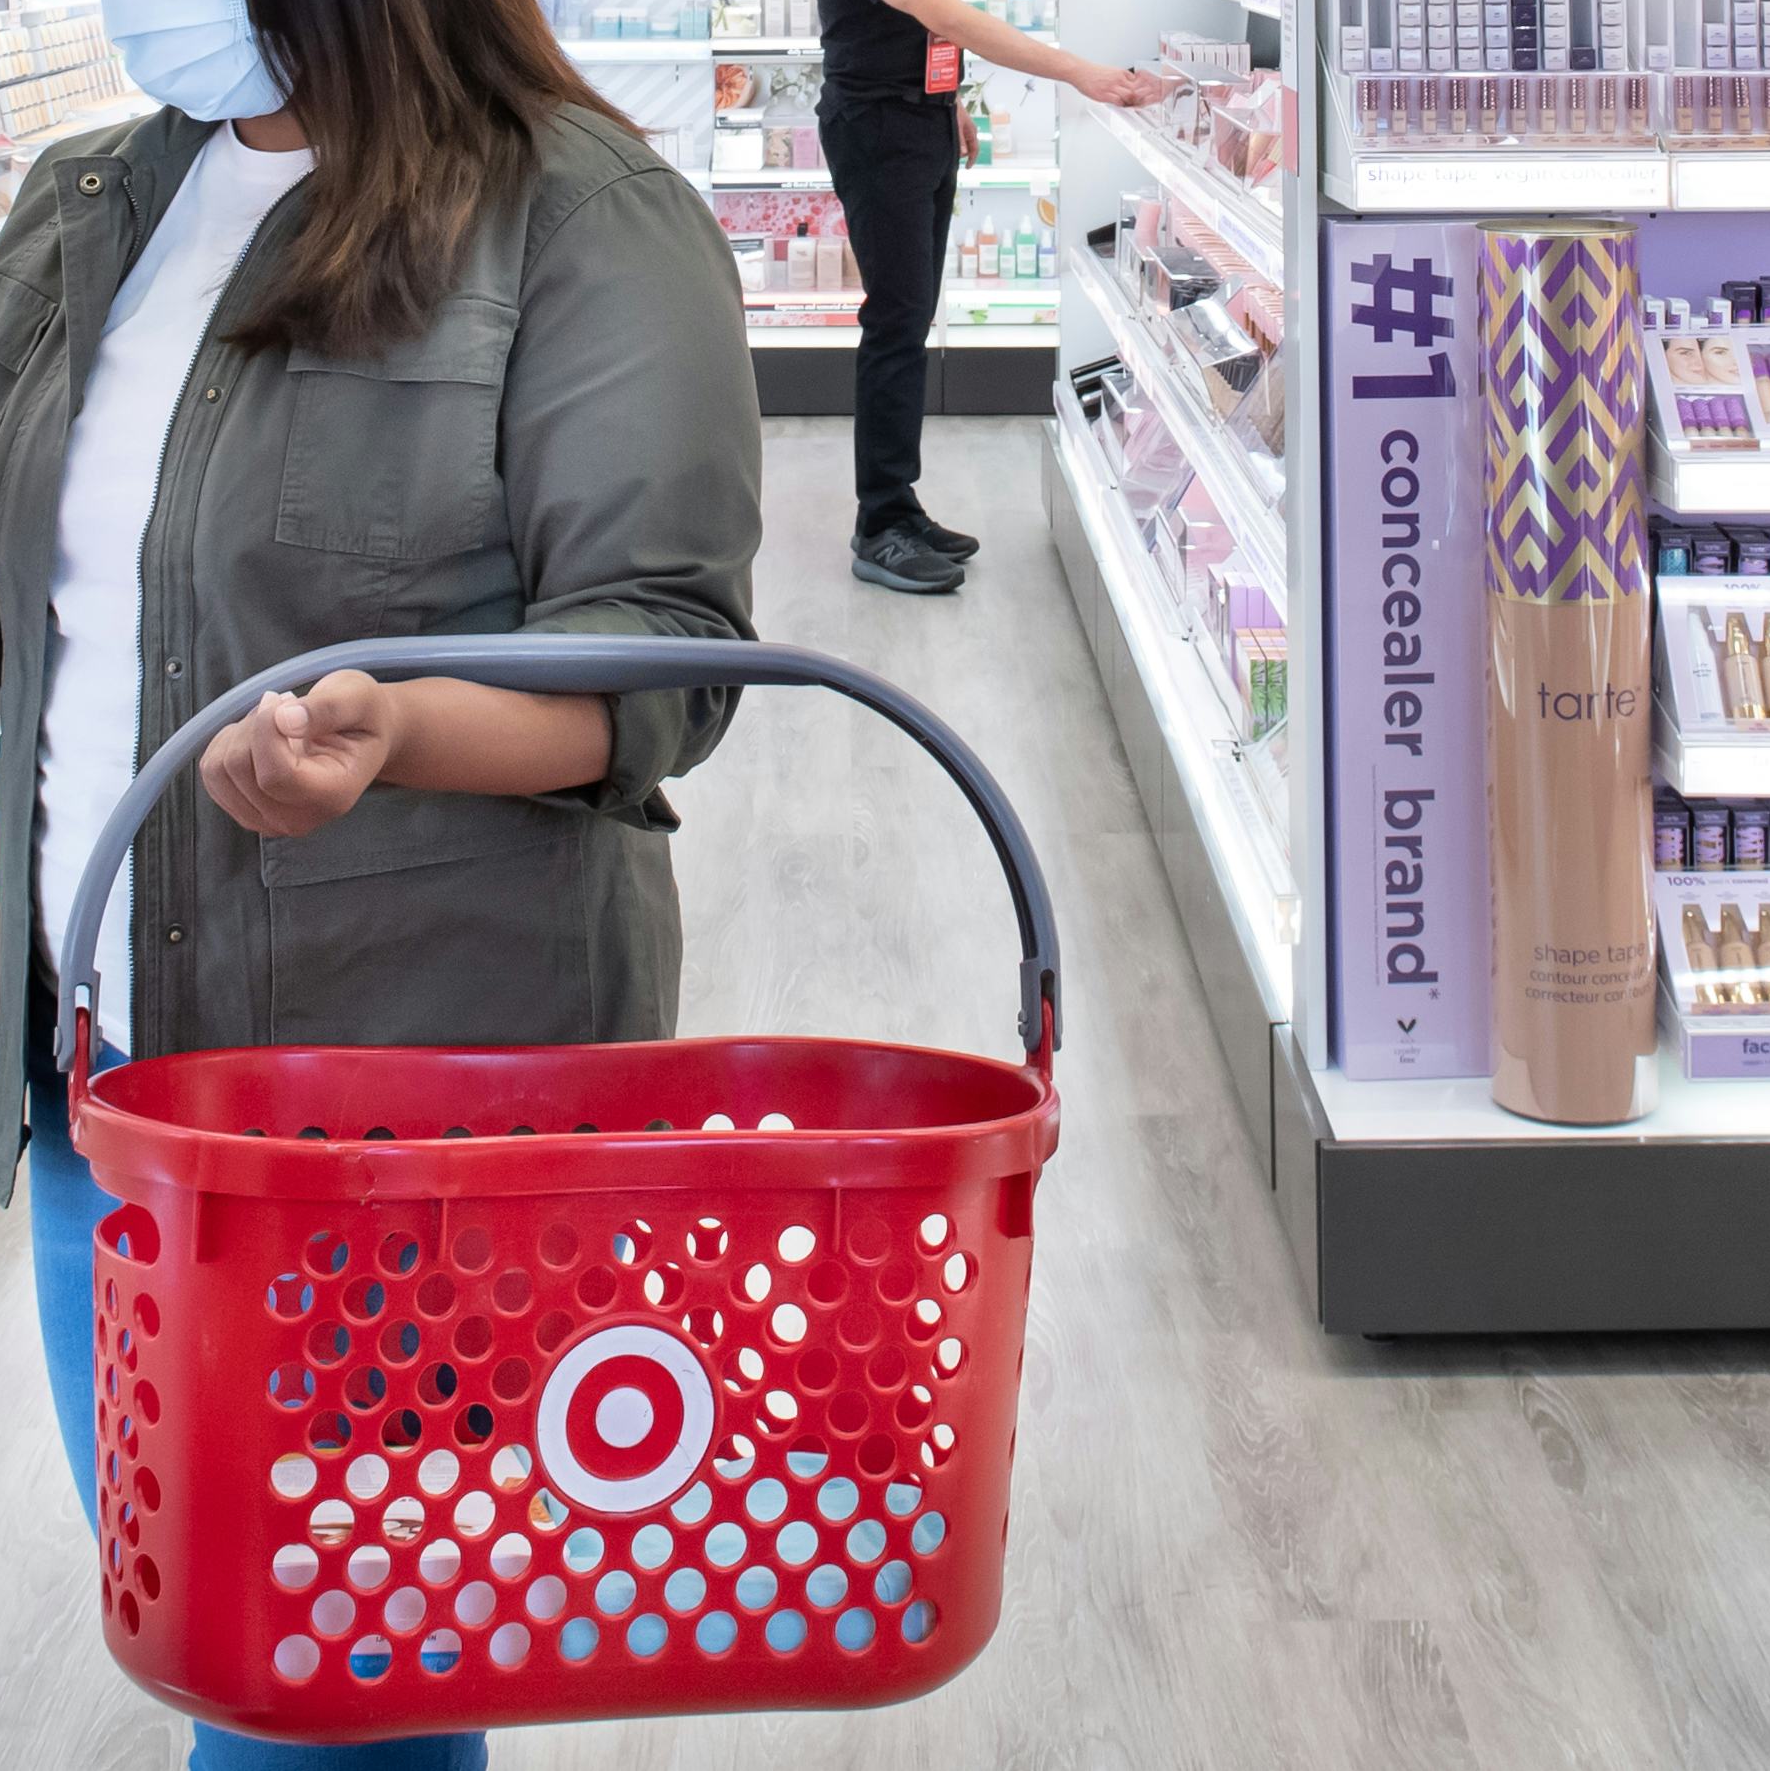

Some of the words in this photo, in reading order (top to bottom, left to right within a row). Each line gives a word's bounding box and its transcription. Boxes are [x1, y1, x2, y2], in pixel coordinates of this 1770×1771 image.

[1368, 166, 1427, 183] shape
[1434, 167, 1478, 183] tape
[1494, 168, 1553, 183] vegan
[1562, 166, 1658, 182] concealer
[1350, 253, 1456, 400] #1
[1380, 428, 1435, 757] concealer
[1538, 682, 1637, 722] tarte
[1384, 789, 1439, 984] brand
[1667, 876, 1706, 886] 100%
[1534, 944, 1601, 967] shape
[1607, 942, 1646, 963] tape
[1529, 970, 1587, 985] contour
[1525, 987, 1599, 1004] correcteur
